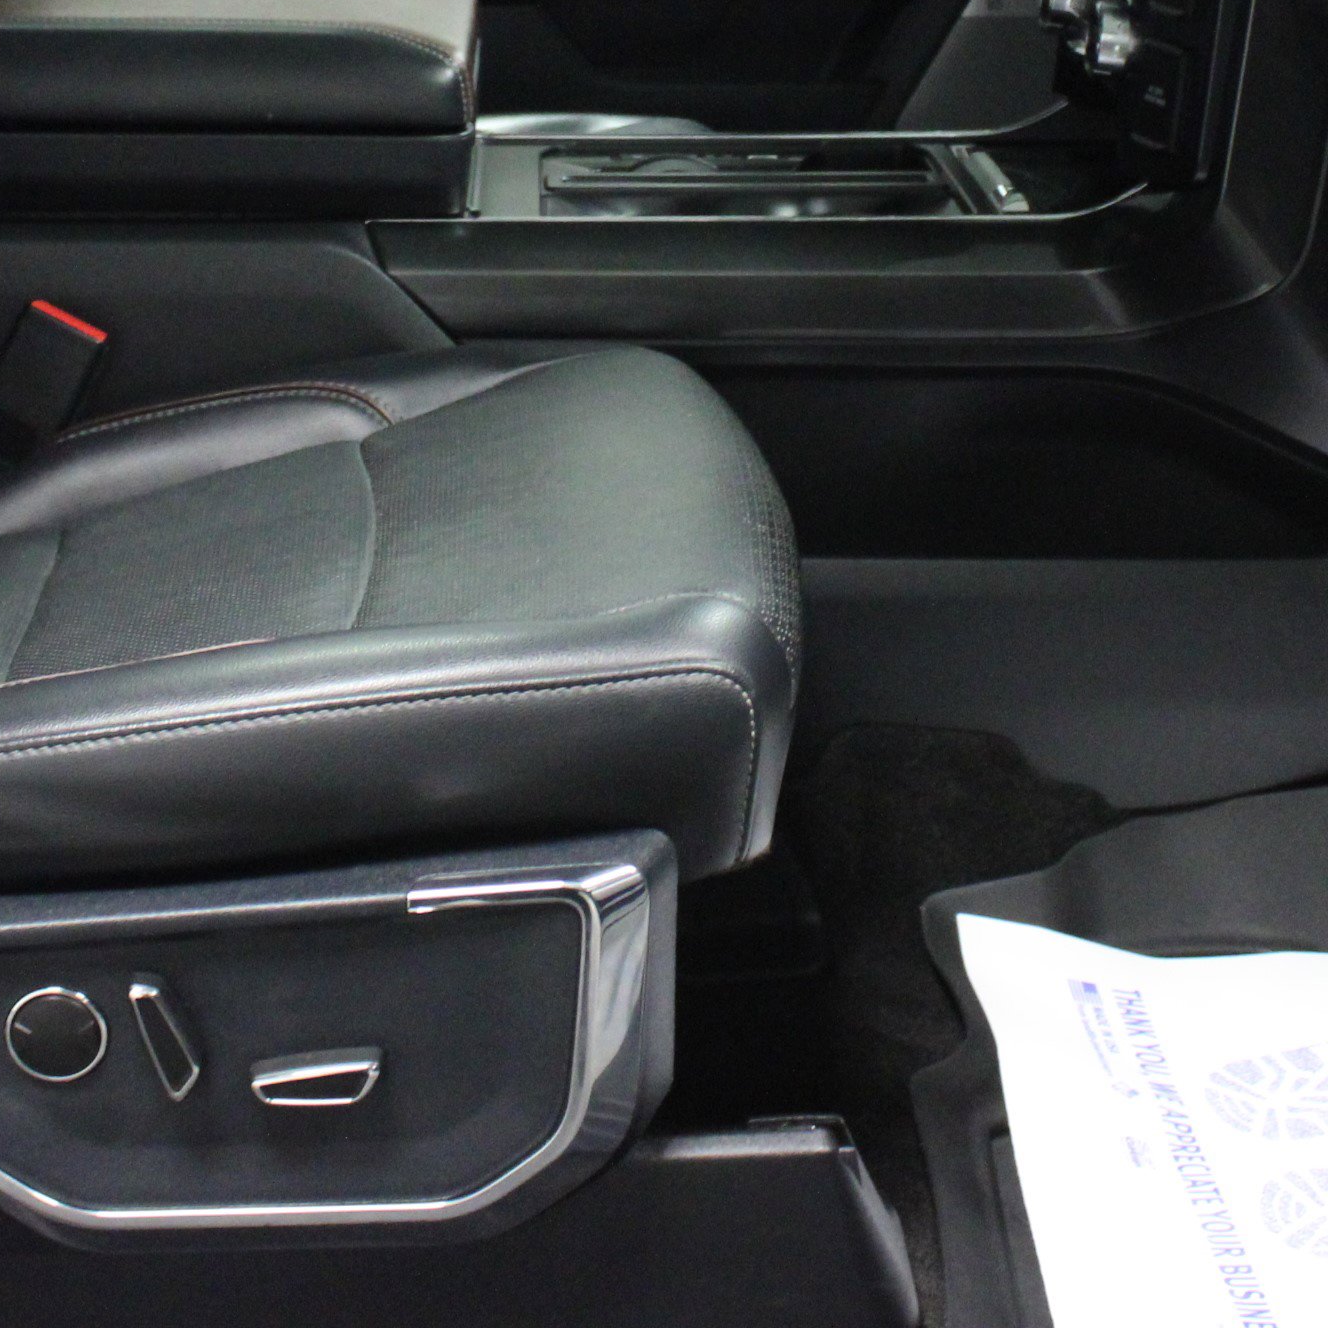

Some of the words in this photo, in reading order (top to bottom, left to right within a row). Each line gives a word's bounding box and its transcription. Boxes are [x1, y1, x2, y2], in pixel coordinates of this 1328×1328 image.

[1111, 988, 1158, 1040] THANK
[1148, 1080, 1185, 1107] WE
[1159, 1103, 1225, 1207] APPRECIATE
[1196, 1208, 1247, 1258] YOUR
